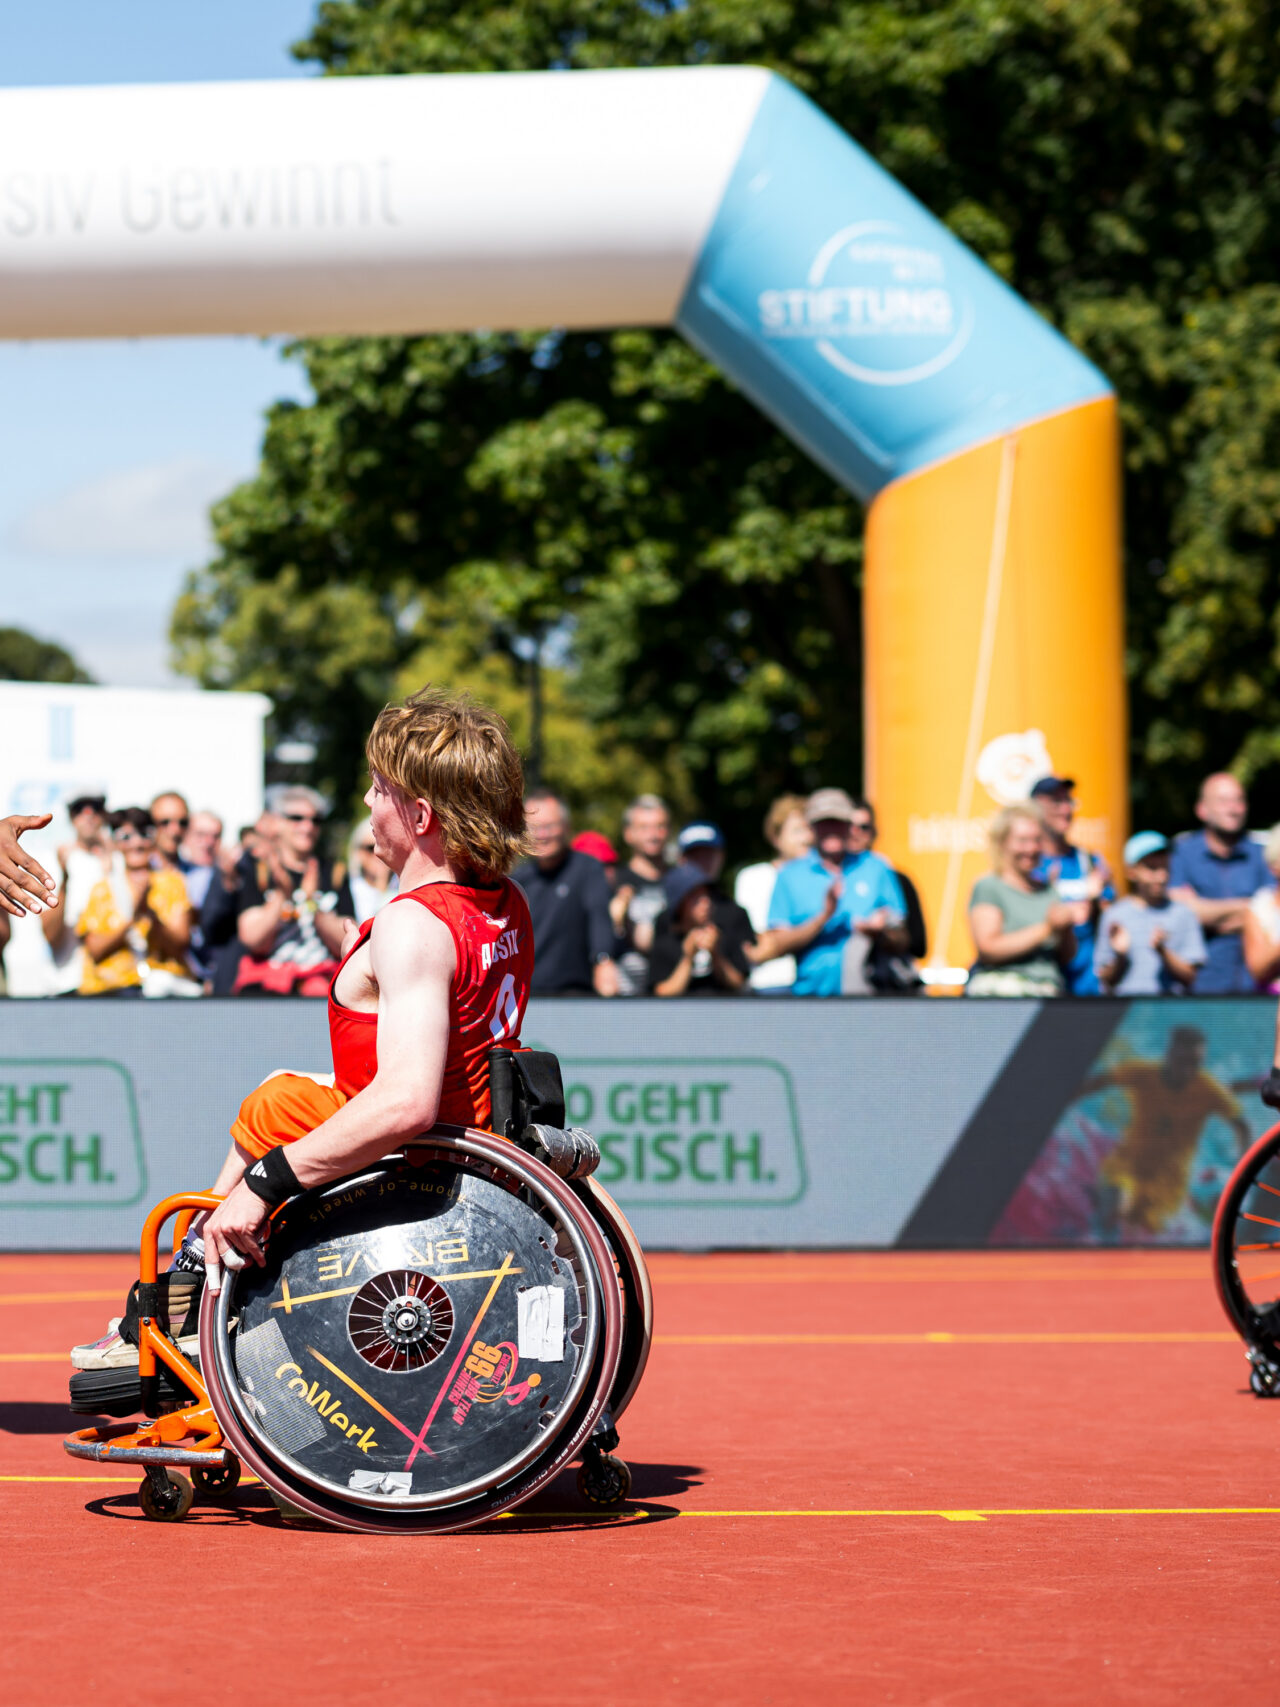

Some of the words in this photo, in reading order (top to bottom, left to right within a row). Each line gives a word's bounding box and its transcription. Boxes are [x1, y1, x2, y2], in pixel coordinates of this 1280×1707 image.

[759, 286, 954, 326] STIFTUNG
[489, 973, 519, 1041] 0
[565, 1083, 594, 1124] O
[607, 1083, 730, 1124] GEHT
[318, 1238, 469, 1281] BRVE
[464, 1340, 503, 1379] 99
[275, 1362, 379, 1454] CoWerk
[452, 1398, 472, 1426] TEAM
